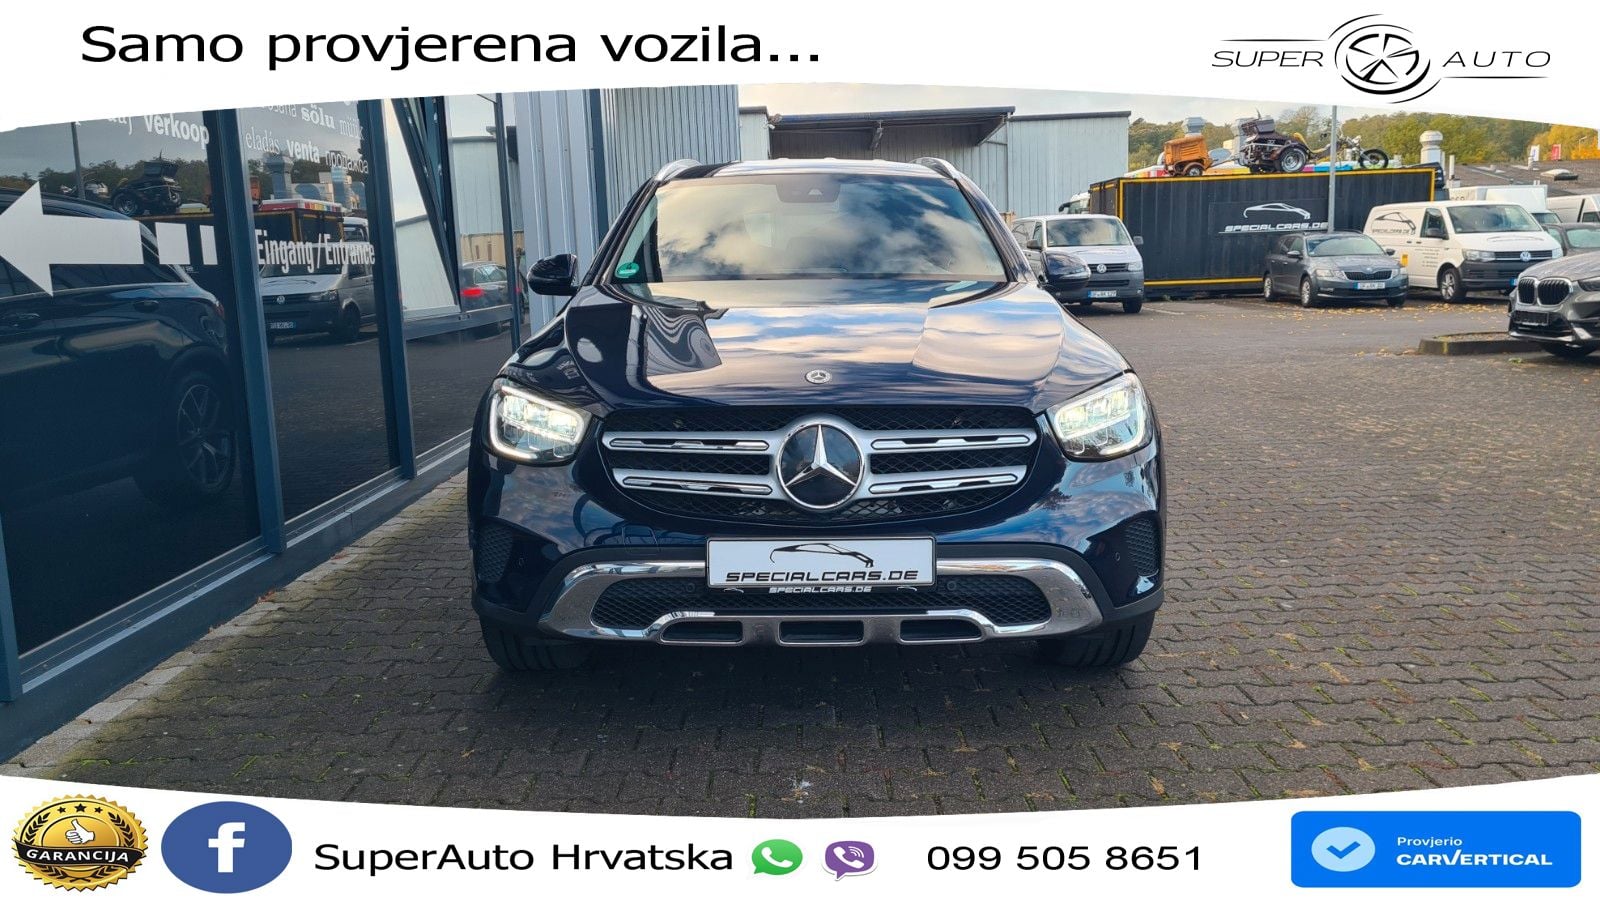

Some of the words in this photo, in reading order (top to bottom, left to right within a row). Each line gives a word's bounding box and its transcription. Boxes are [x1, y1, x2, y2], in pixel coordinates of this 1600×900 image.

[301, 103, 335, 129] sölu
[245, 126, 280, 154] eladás
[286, 139, 320, 164] venta
[1224, 221, 1329, 233] SPECIALCARS.DE
[254, 228, 315, 274] Eingang
[324, 233, 376, 266] Entrance
[725, 569, 919, 583] SPECIALCARS.DE
